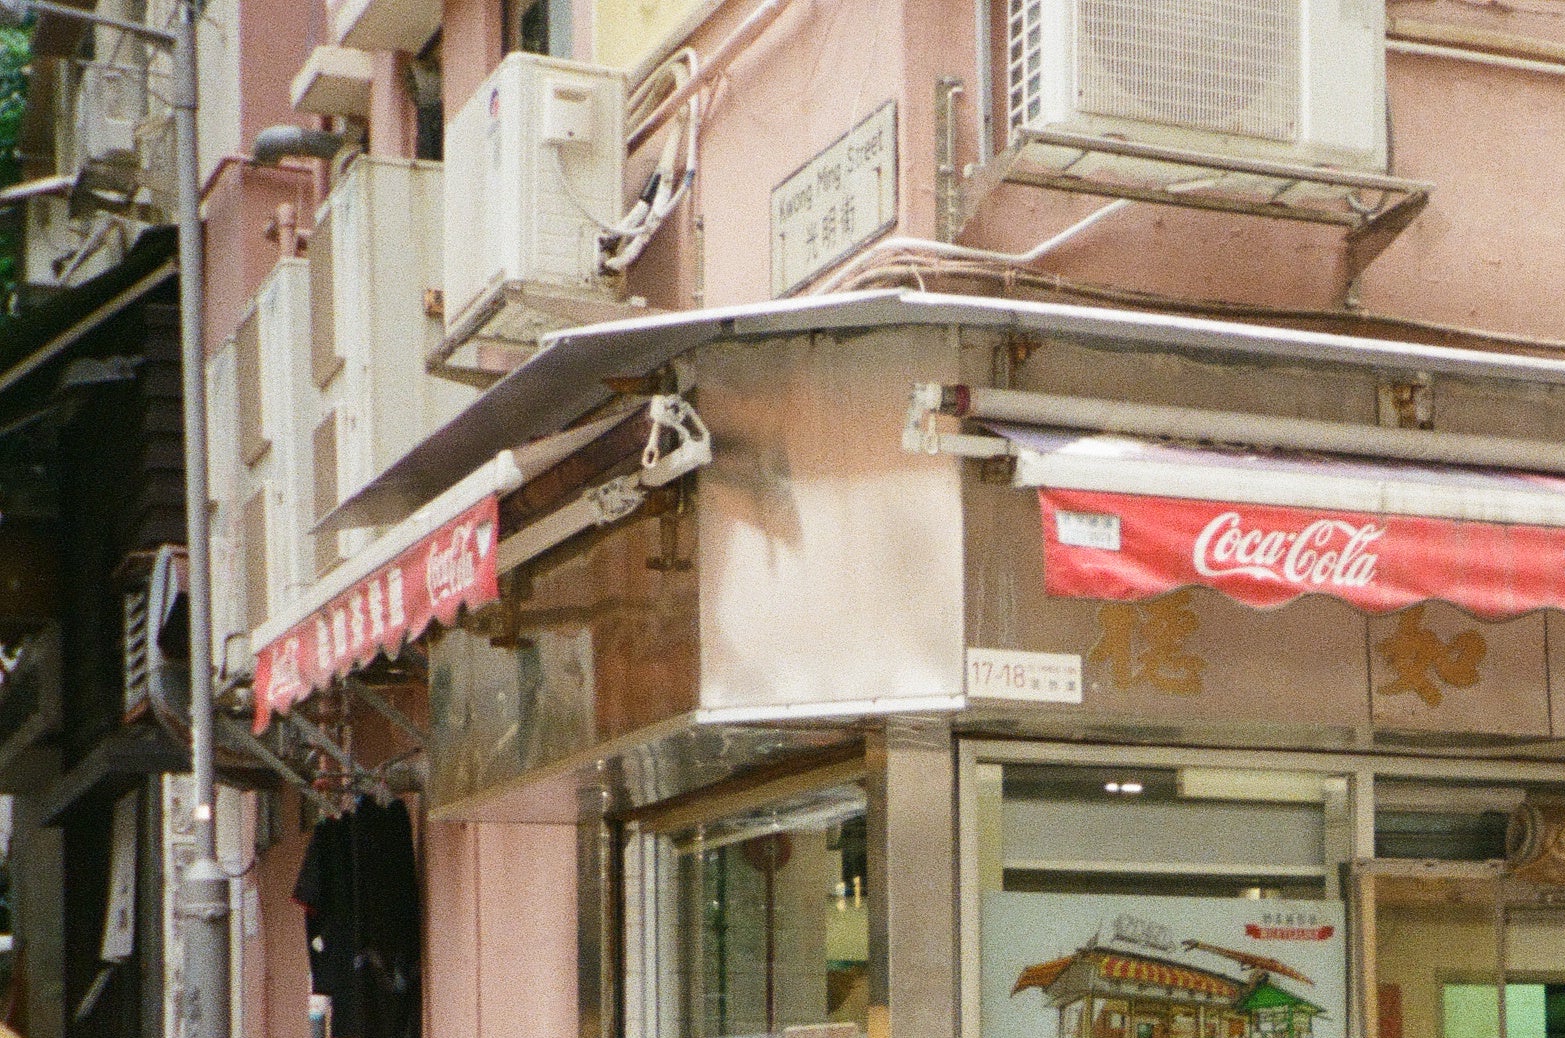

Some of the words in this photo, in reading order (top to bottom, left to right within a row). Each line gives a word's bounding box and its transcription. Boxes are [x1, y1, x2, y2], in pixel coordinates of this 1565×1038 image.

[779, 183, 813, 224] Kwong
[816, 162, 842, 196] Ming
[847, 128, 885, 174] Street
[806, 194, 856, 263] 光明街
[972, 659, 1026, 689] 17-18
